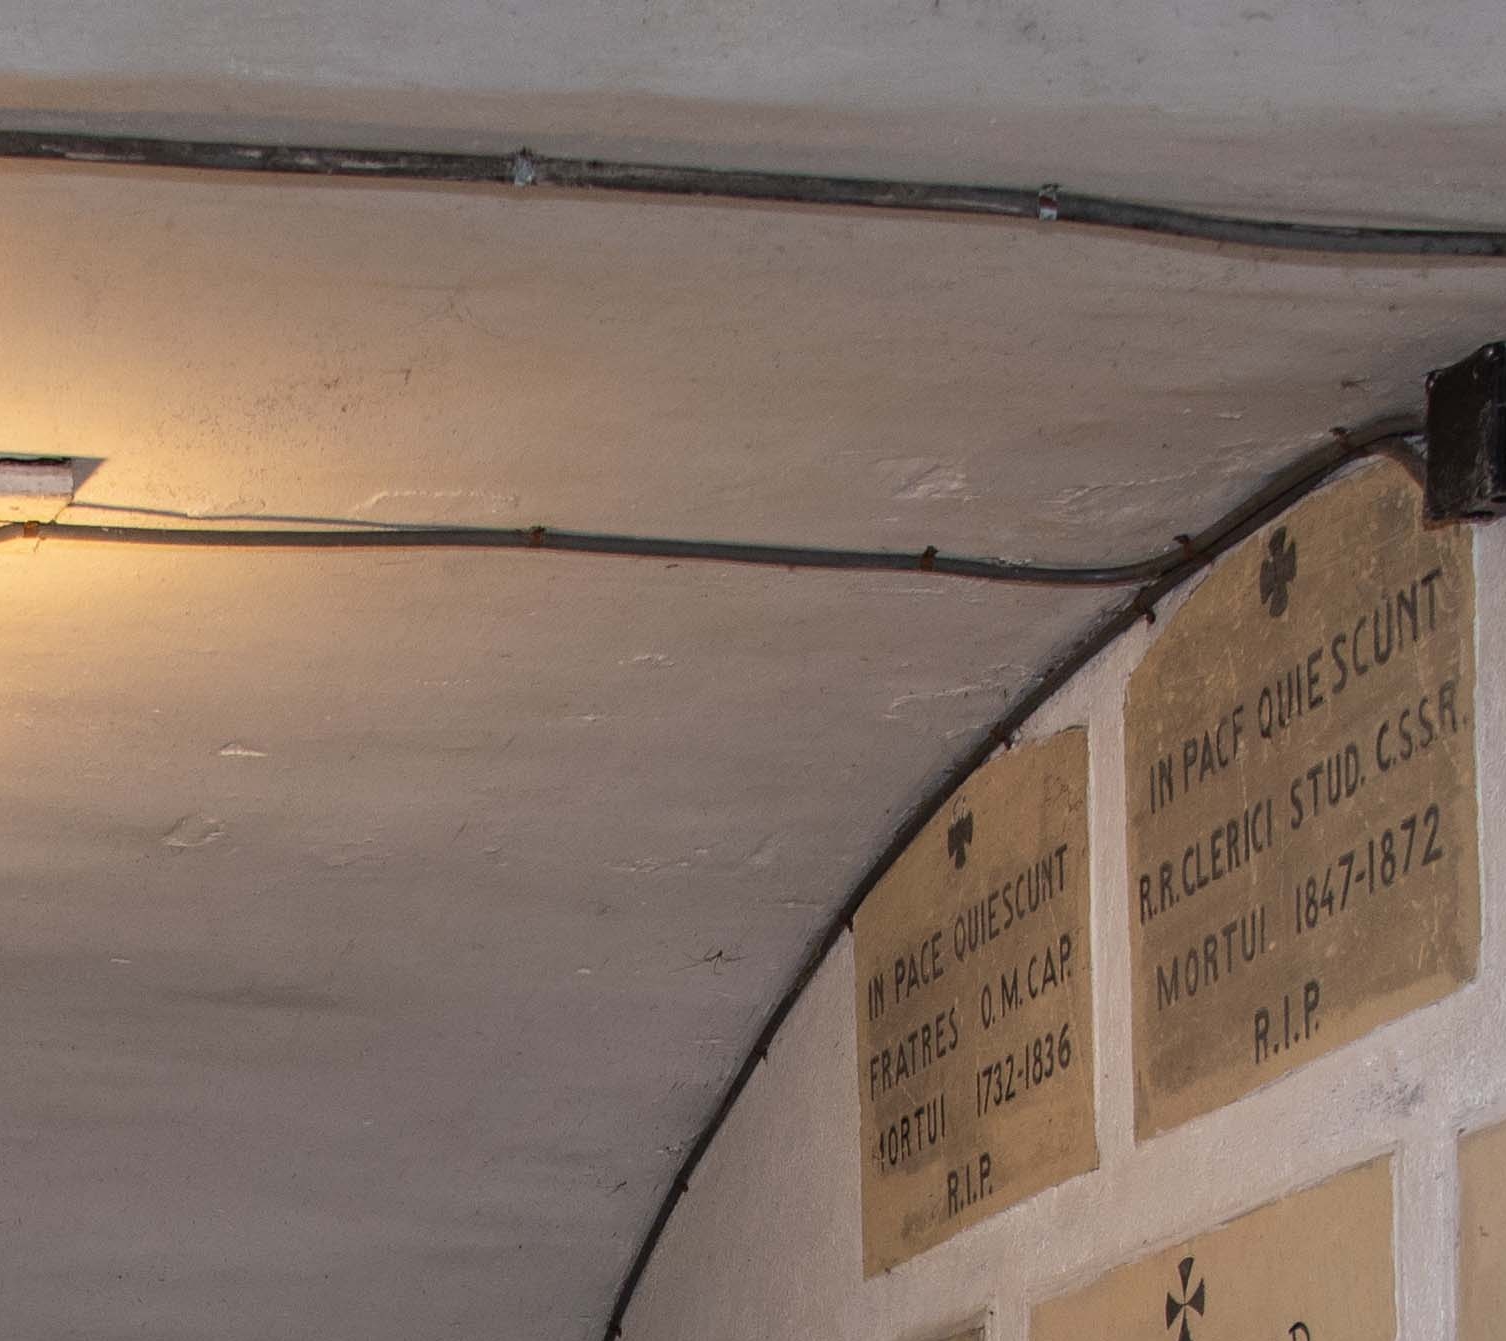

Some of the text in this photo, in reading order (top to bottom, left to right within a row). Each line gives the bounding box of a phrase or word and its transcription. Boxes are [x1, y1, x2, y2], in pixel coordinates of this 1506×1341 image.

[1149, 751, 1174, 814] IN
[1258, 566, 1442, 740] QUIESCUNT
[869, 844, 1067, 1021] IN PACE QUIESCUNT
[1155, 802, 1445, 1012] MORTUI 1847-1872
[870, 1003, 958, 1101] FRATRES
[977, 1022, 1071, 1118] 1732-1836
